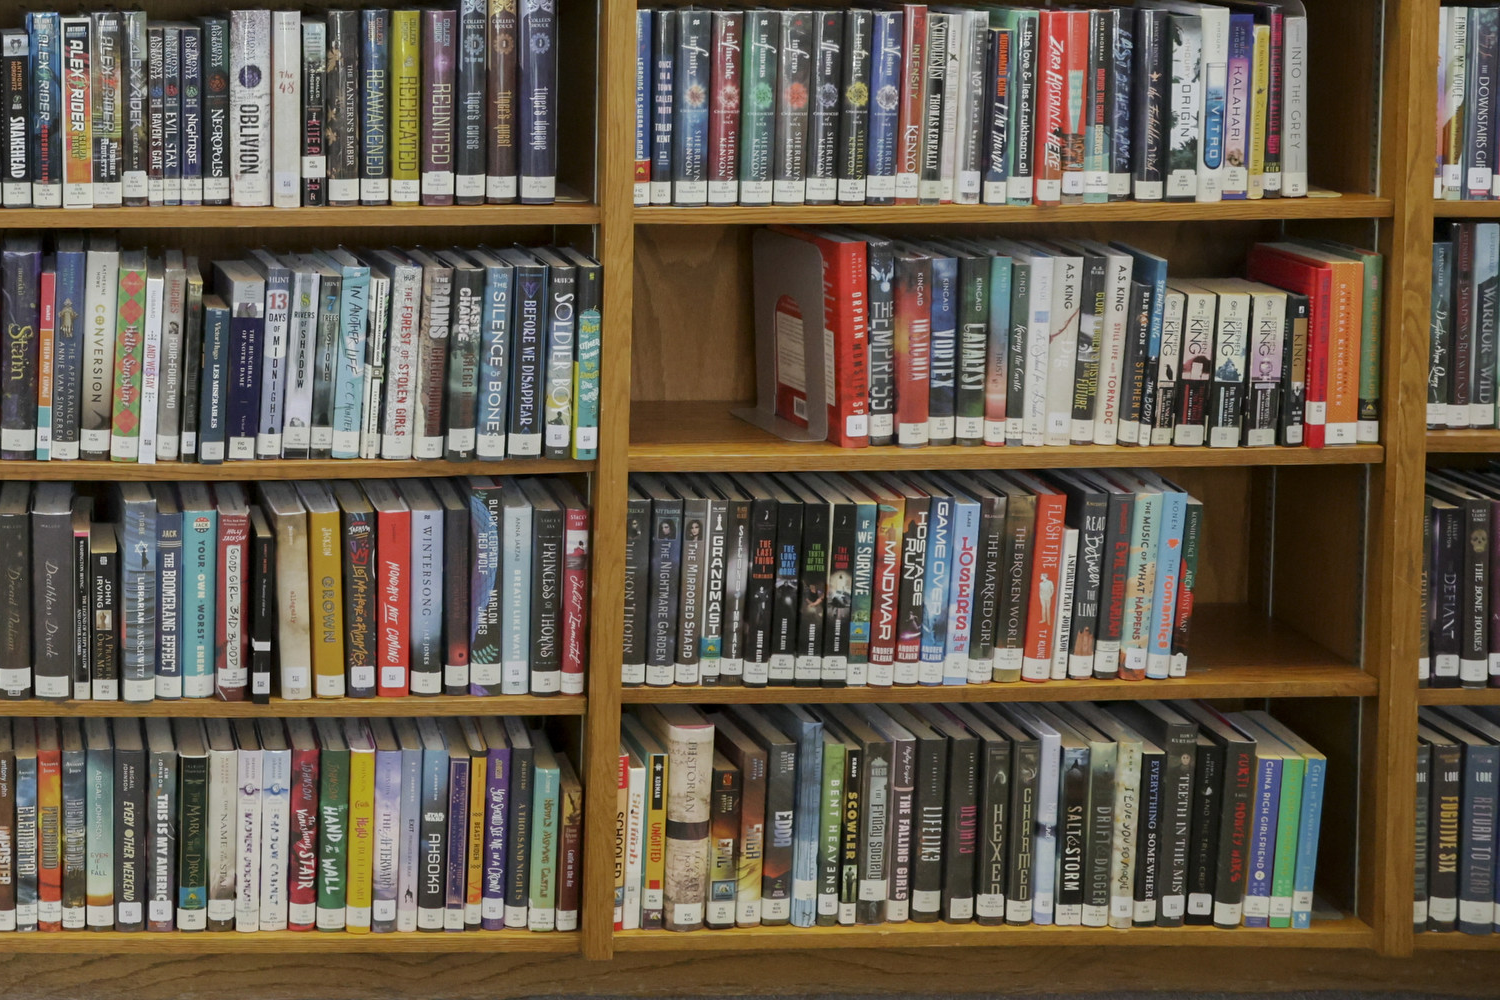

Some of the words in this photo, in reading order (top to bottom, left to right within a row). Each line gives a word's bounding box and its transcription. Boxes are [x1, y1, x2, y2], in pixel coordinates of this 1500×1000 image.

[432, 83, 450, 164] REUNITED
[1181, 85, 1190, 137] ORIGIN
[1232, 65, 1242, 142] KALAHARI
[10, 117, 25, 178] SNAKEHEAD
[239, 104, 259, 174] OBLIVION
[1210, 106, 1218, 159] VITRO
[269, 313, 286, 322] DAYS
[270, 293, 287, 309] 13
[523, 300, 536, 342] BEFORE
[1065, 285, 1073, 309] KING
[8, 325, 33, 381] Stain
[91, 304, 105, 402] CONVERSION
[522, 347, 534, 362] WE
[520, 366, 534, 425] DISAPPEAR
[858, 531, 872, 544] WE
[96, 576, 104, 608] IRVING
[423, 526, 432, 616] WINTERSONG
[855, 547, 871, 596] SURVIVE
[878, 541, 896, 640] MINDWAR
[955, 536, 973, 631] LOSERS
[323, 806, 342, 841] HAND
[830, 780, 839, 816] BENT
[1440, 796, 1458, 848] FUGITIVE
[651, 822, 661, 862] UNGIFTED
[846, 792, 857, 858] SCOWLER
[323, 858, 339, 894] WALL
[428, 833, 440, 894] AHSOKA
[1439, 853, 1456, 873] SIX
